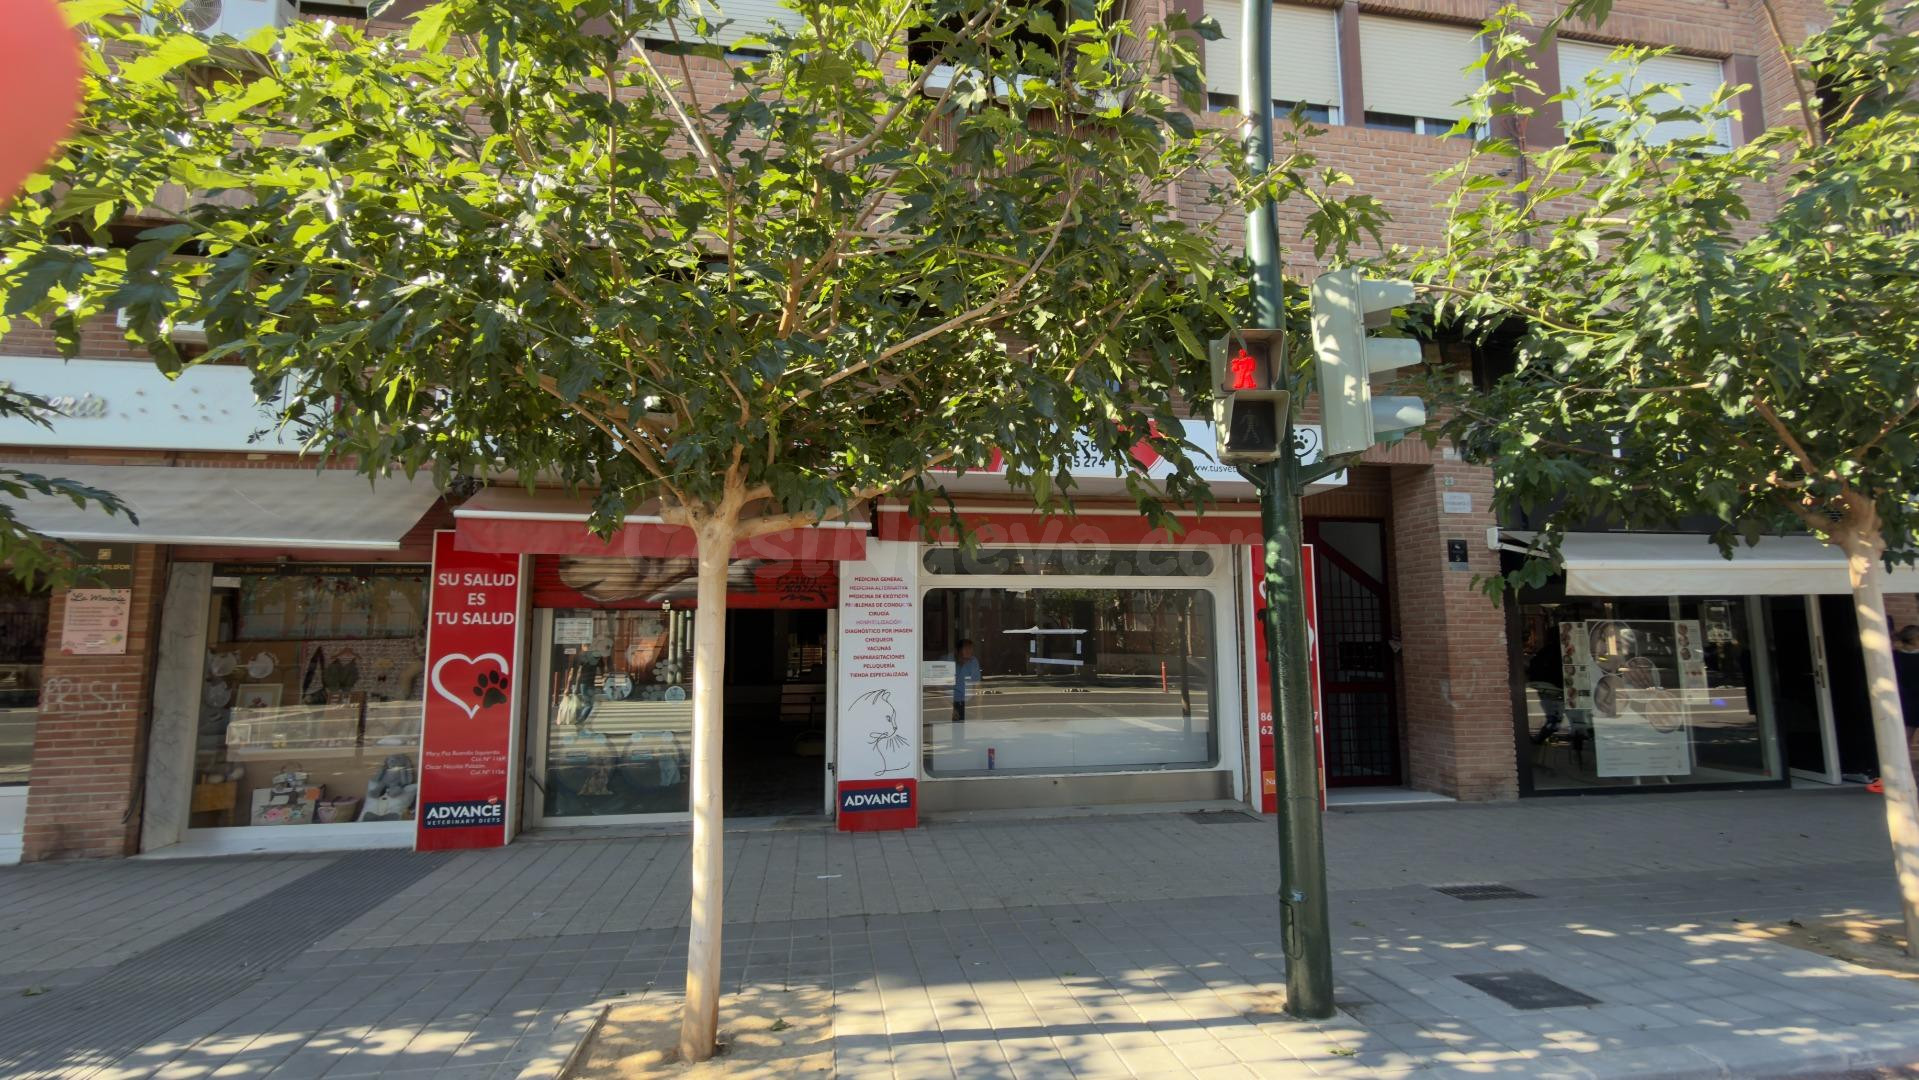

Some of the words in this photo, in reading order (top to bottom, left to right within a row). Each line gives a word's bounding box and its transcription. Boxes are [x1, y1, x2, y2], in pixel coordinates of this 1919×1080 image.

[1083, 456, 1106, 468] 274
[437, 572, 460, 587] SU
[463, 572, 517, 587] SALUD
[467, 591, 487, 606] ES
[435, 611, 459, 626] TU
[461, 611, 516, 626] SALUD
[1259, 711, 1273, 722] 86
[1260, 725, 1274, 735] 62
[844, 792, 908, 807] ADVANCE
[426, 804, 502, 820] ADVANCE
[427, 818, 476, 826] VETERINARY
